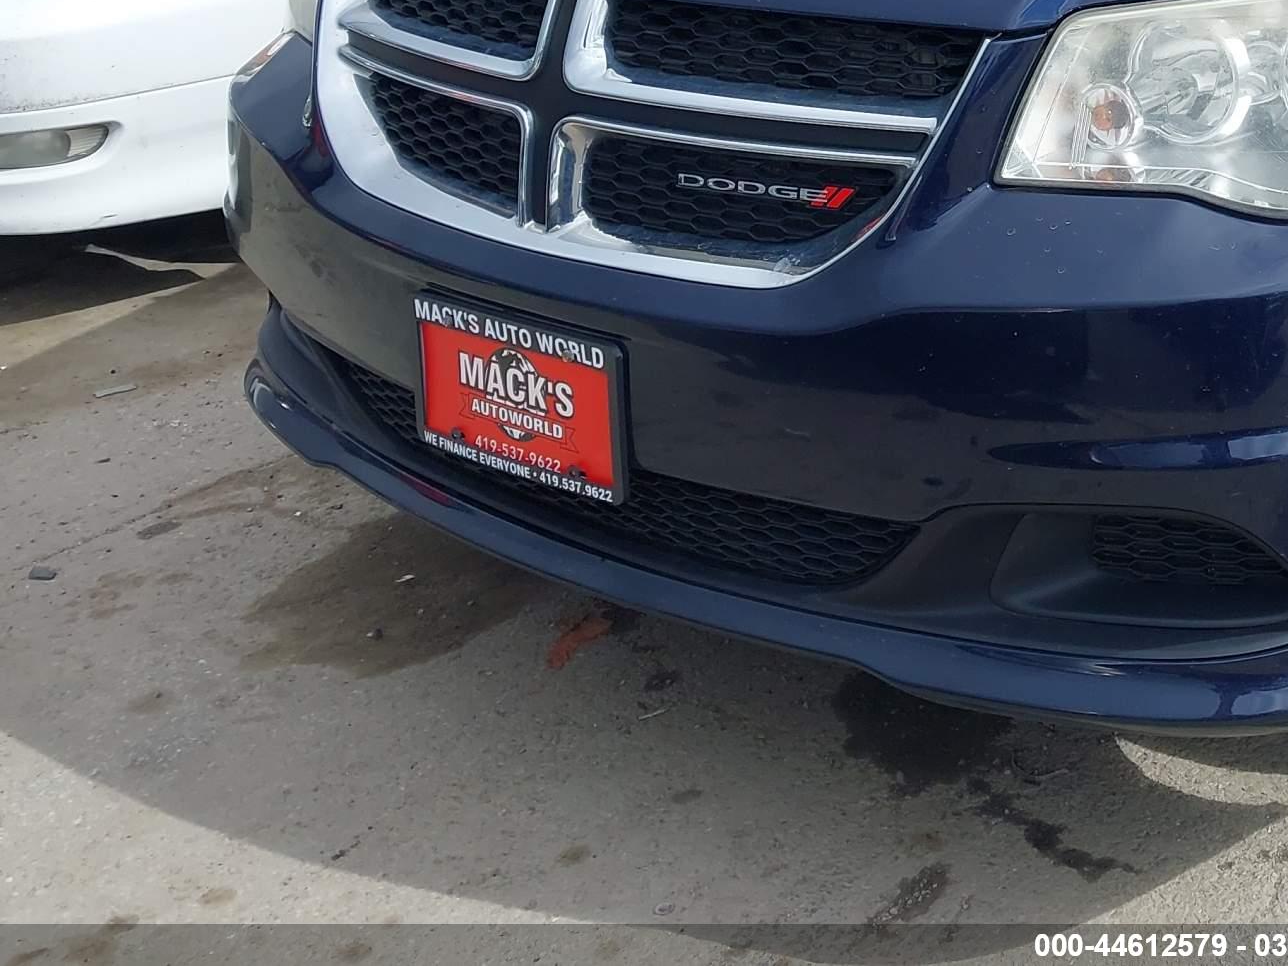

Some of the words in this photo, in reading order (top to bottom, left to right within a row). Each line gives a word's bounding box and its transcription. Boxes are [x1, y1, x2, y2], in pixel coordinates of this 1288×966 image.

[676, 172, 829, 203] DODGE
[413, 298, 480, 334] MACK'S
[484, 318, 532, 349] AUTO
[536, 332, 604, 369] WORLD
[458, 351, 575, 418] MACK'S
[471, 398, 564, 440] AUTOWORLD
[423, 430, 438, 445] WE
[438, 436, 479, 462] FINANCE
[479, 451, 532, 480] EVERYONE
[539, 471, 614, 503] 419.537.9622
[474, 434, 562, 474] 419-537-9622
